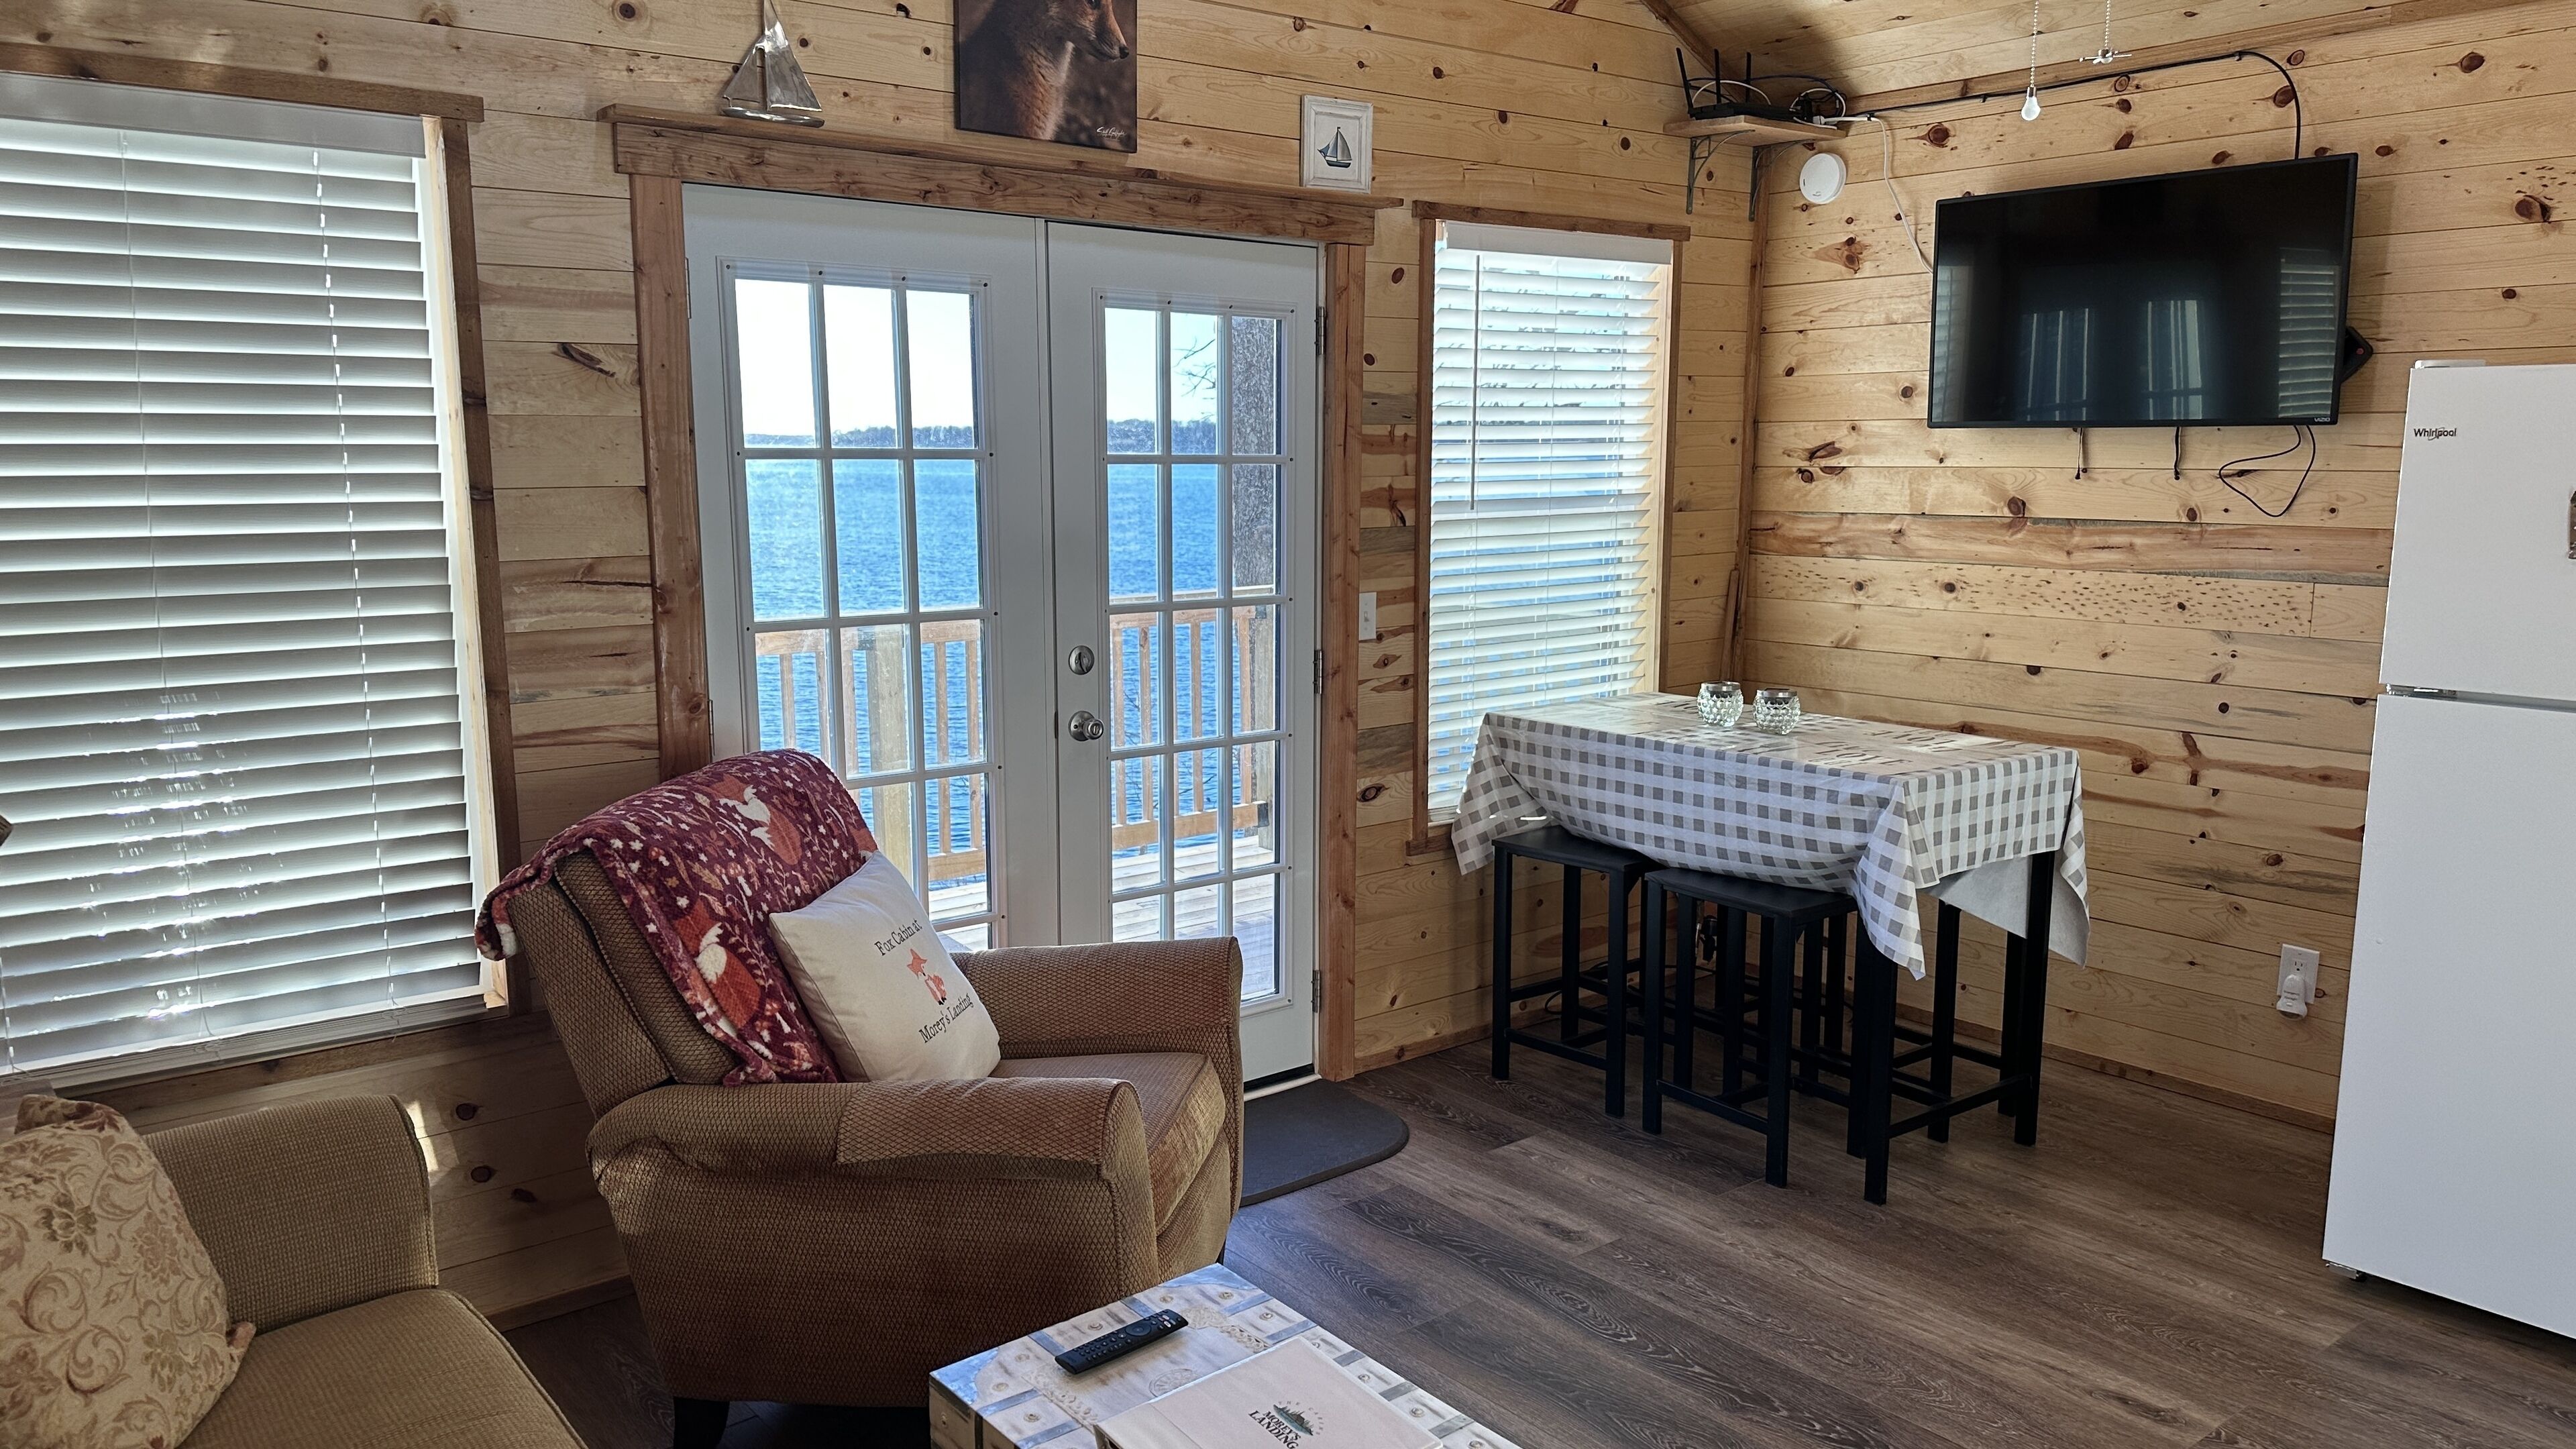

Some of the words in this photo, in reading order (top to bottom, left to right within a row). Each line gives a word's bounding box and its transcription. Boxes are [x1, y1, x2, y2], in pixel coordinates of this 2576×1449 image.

[2414, 427, 2457, 441] Whirlpool
[1862, 730, 1957, 745] LOVE
[1815, 749, 1914, 766] LOVE
[874, 938, 896, 956] Fox
[891, 924, 916, 945] Cabin
[912, 918, 922, 932] at
[918, 1010, 951, 1043] Morey's
[947, 993, 973, 1020] Landing
[1248, 1410, 1299, 1449] LANDING
[1263, 1411, 1301, 1442] MOREY'S
